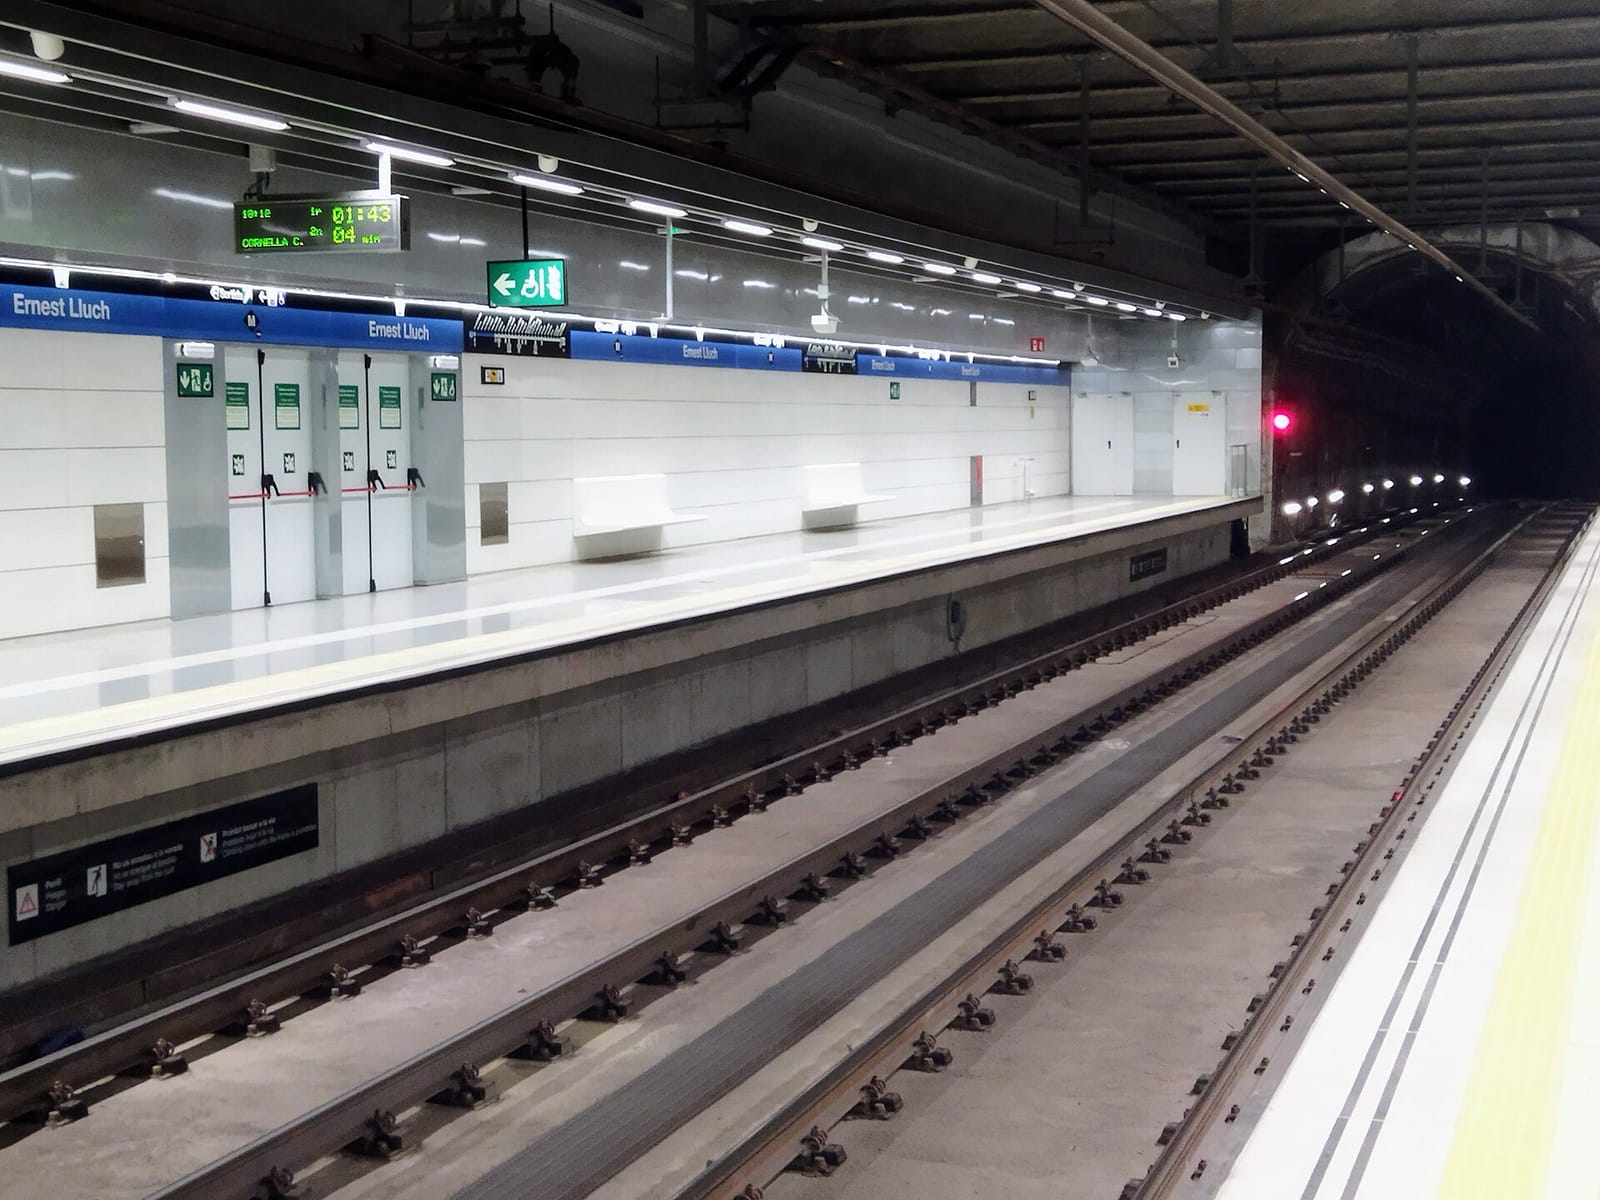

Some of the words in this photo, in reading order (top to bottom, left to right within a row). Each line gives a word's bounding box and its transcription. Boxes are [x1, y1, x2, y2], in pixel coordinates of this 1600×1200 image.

[332, 205, 391, 224] 01:43
[292, 236, 304, 246] C.
[332, 226, 356, 244] 04
[361, 234, 381, 244] min
[13, 293, 66, 317] Ernest
[69, 297, 110, 320] Lluch
[368, 320, 402, 339] Ernest
[403, 322, 430, 341] Lluch
